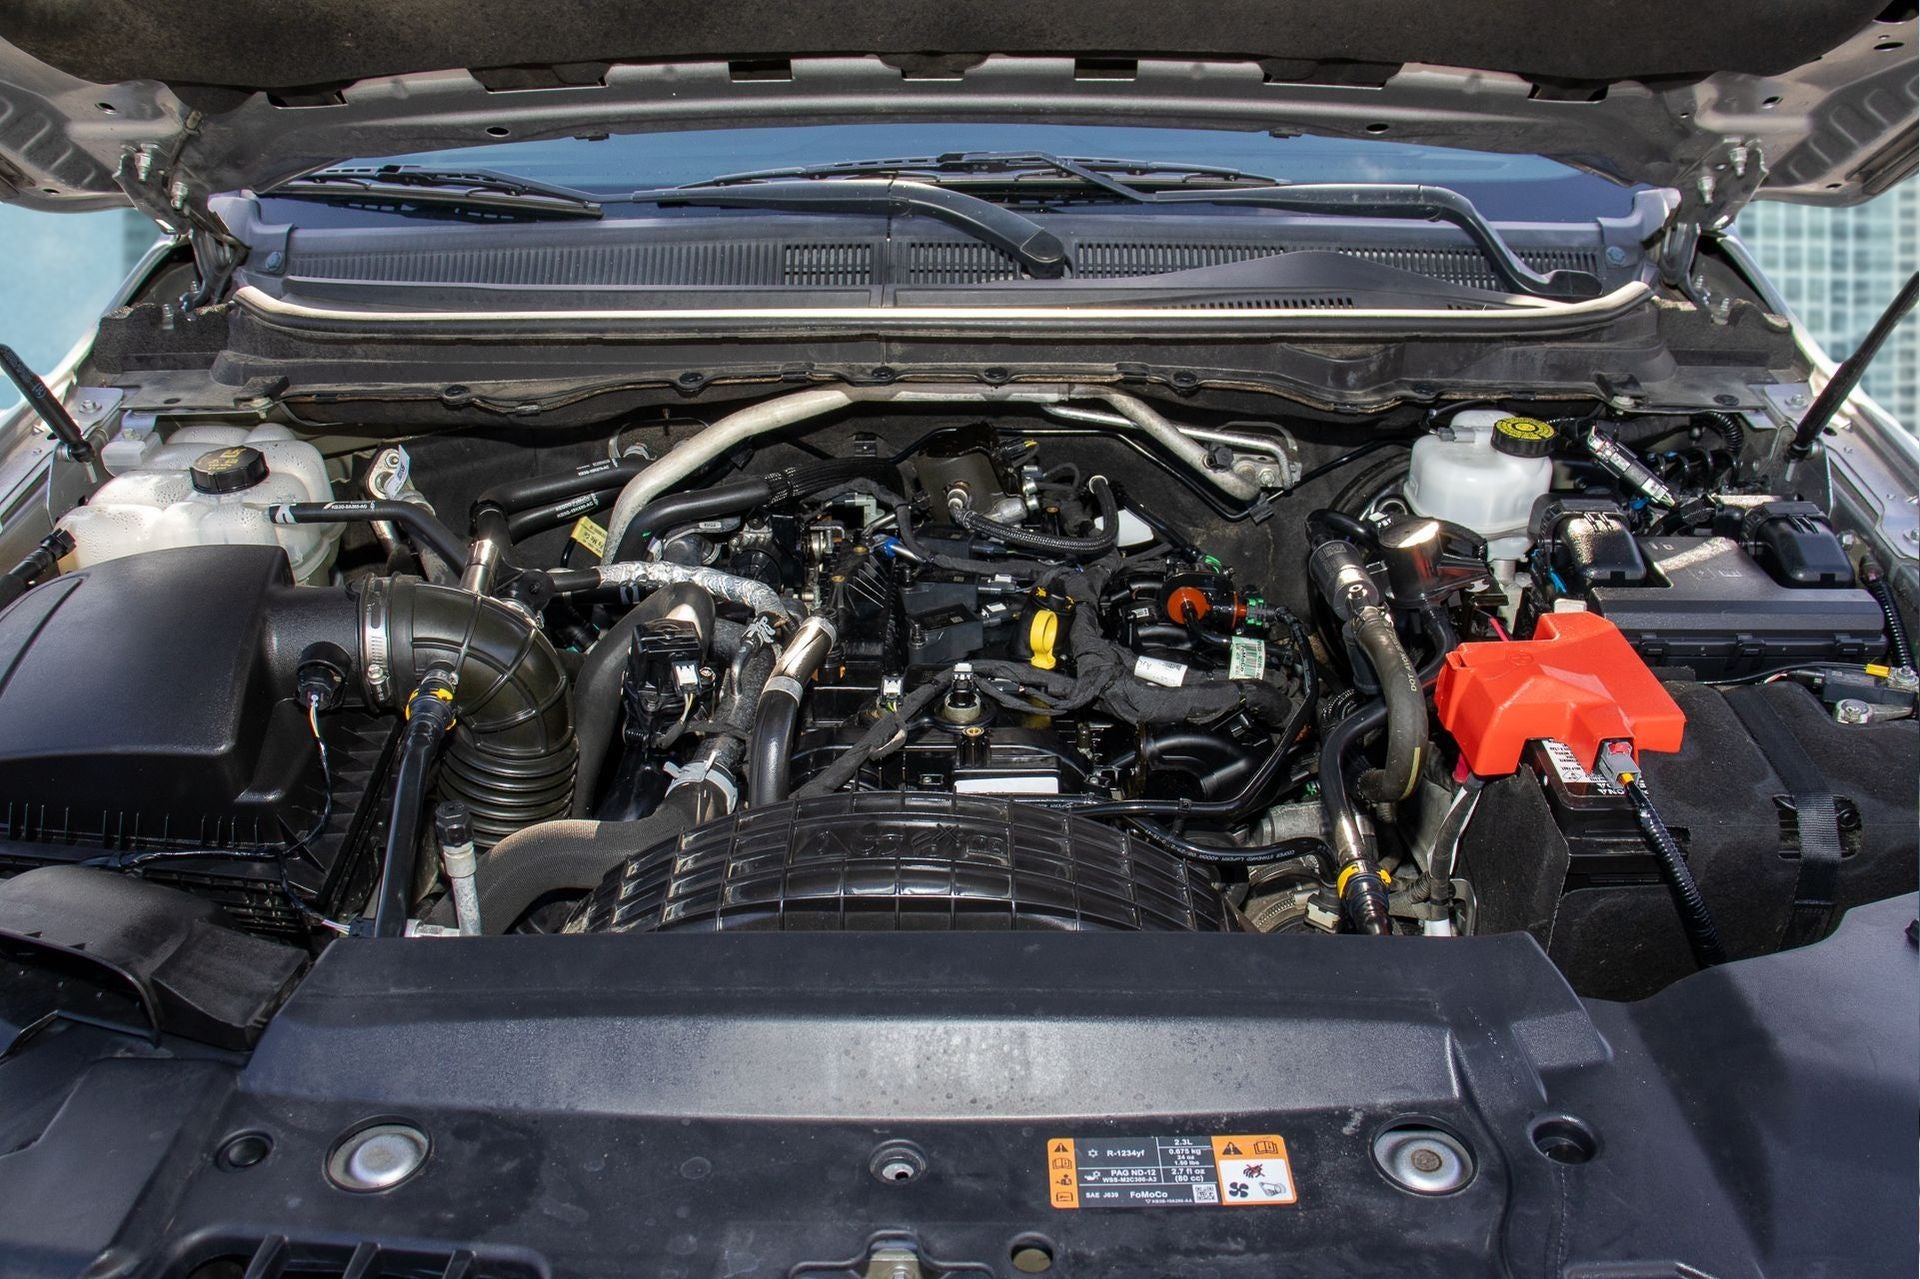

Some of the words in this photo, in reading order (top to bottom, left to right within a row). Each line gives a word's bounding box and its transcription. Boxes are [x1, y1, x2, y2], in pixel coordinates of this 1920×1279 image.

[1106, 1149, 1145, 1158] R-1234yf
[1191, 1148, 1202, 1156] kg
[1174, 1175, 1191, 1183] (80
[1191, 1174, 1204, 1183] cc)
[1129, 1191, 1168, 1199] FoMoCo
